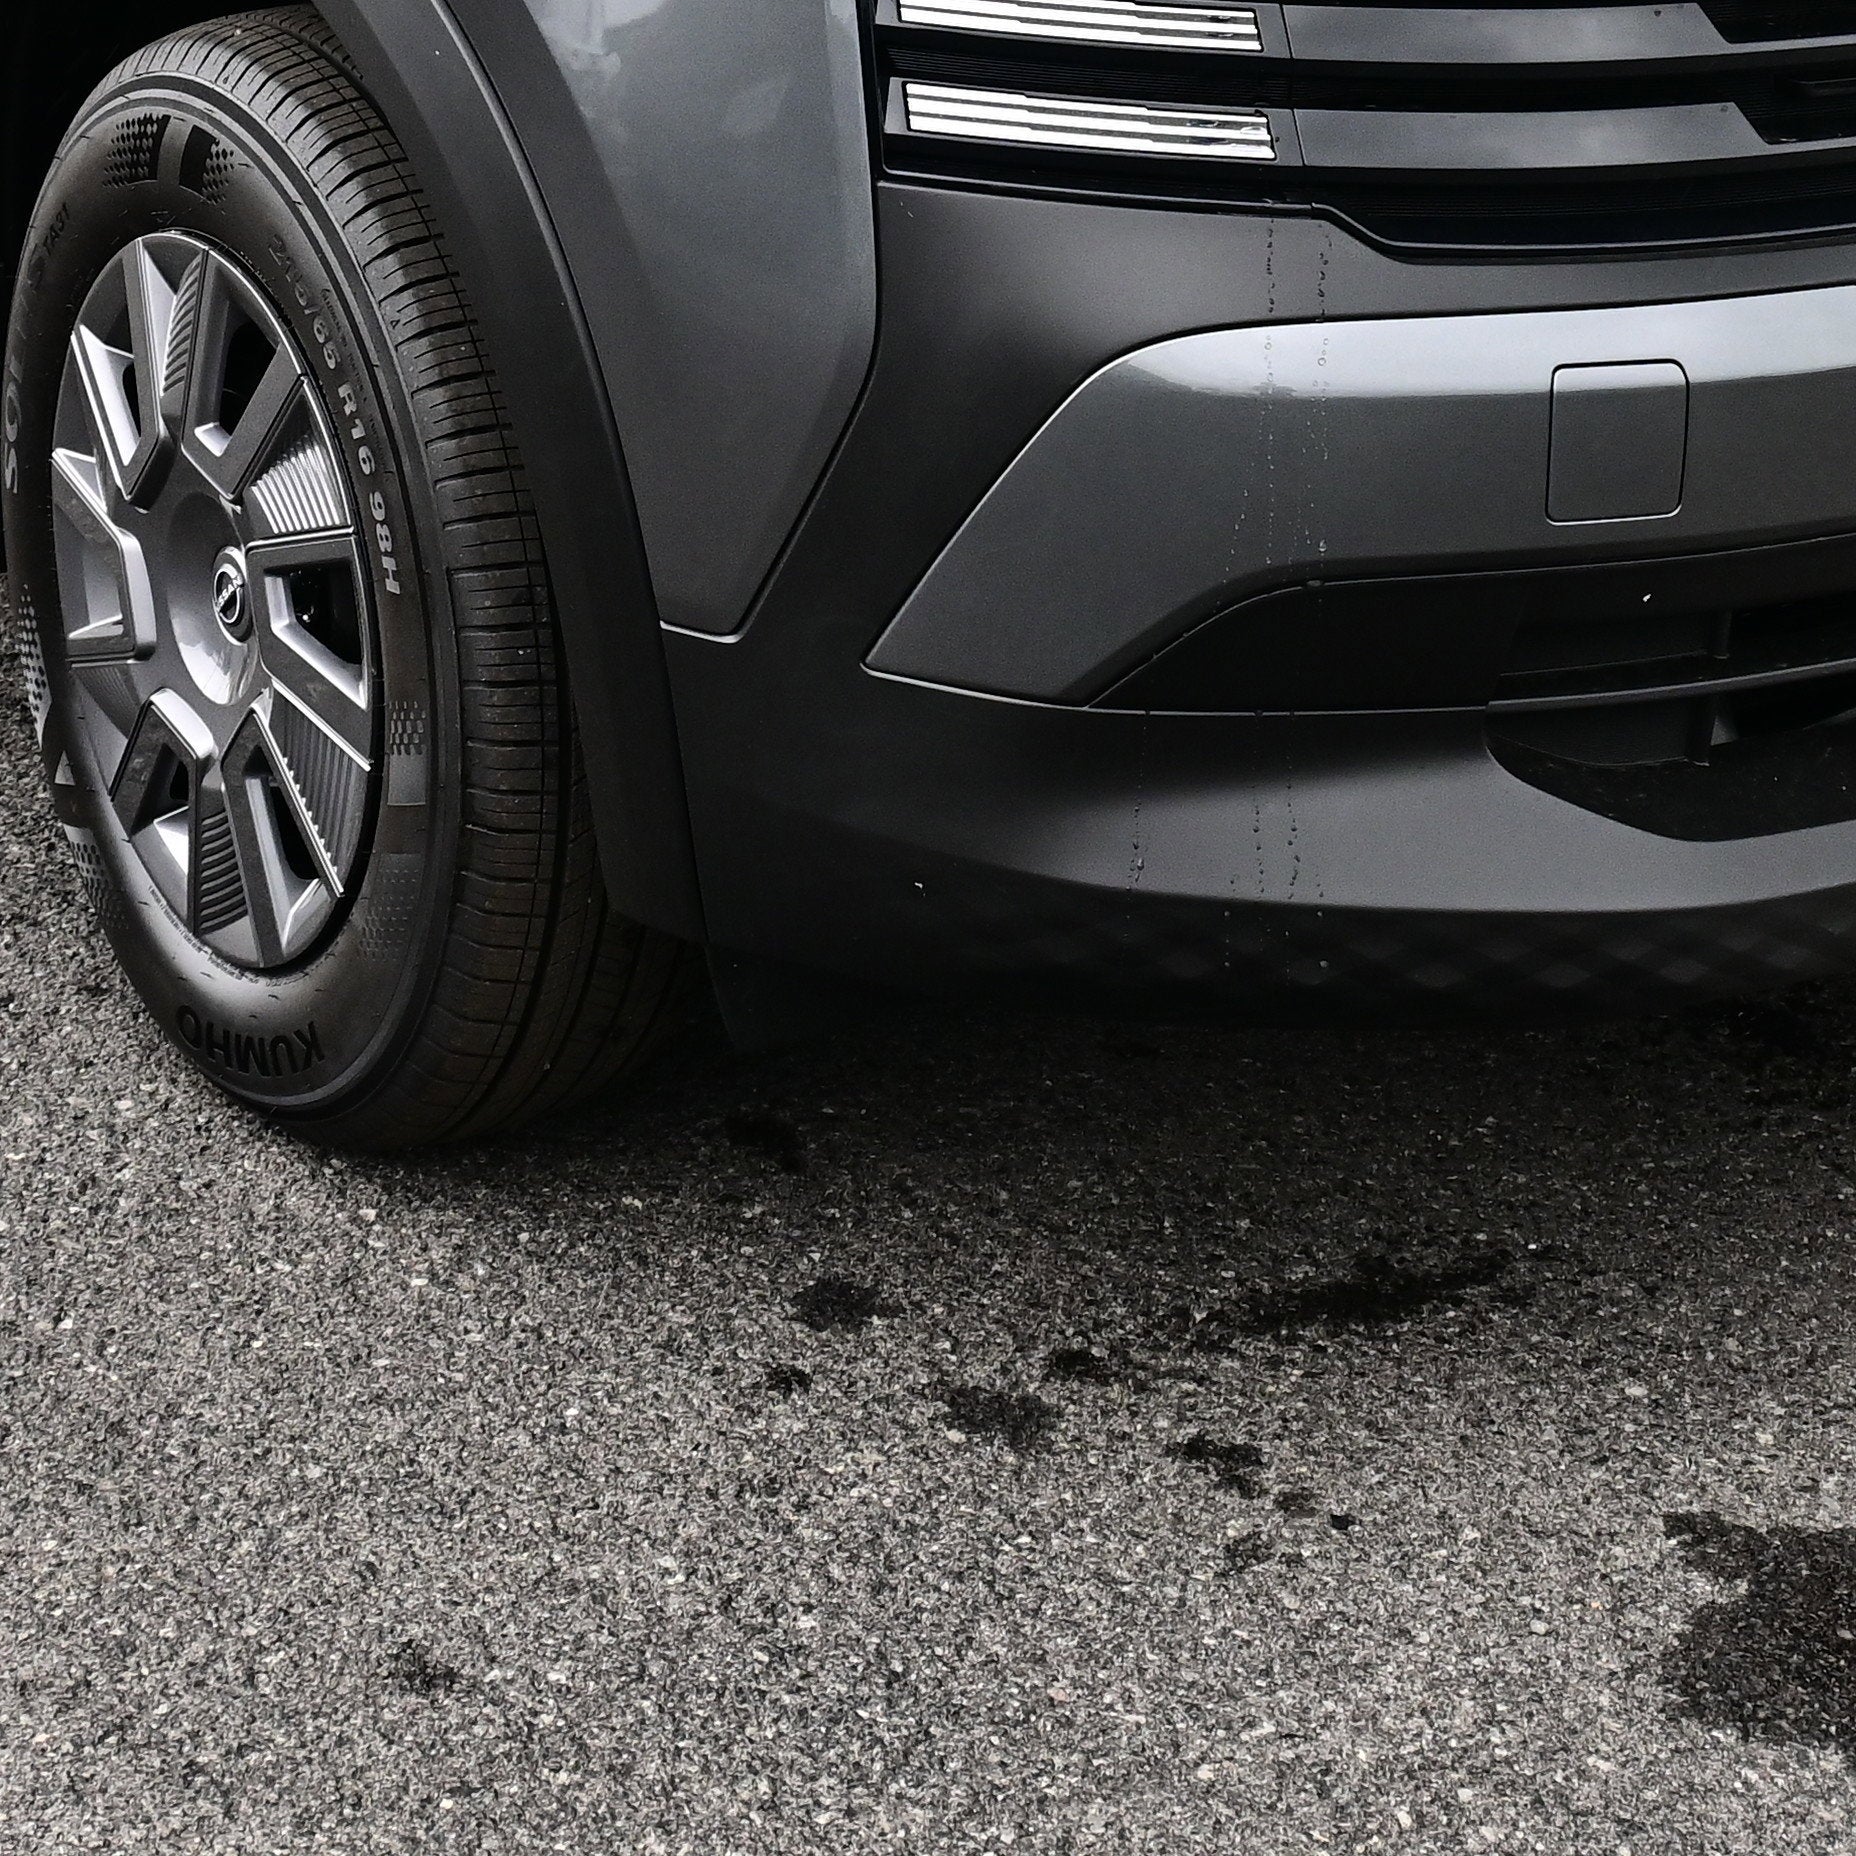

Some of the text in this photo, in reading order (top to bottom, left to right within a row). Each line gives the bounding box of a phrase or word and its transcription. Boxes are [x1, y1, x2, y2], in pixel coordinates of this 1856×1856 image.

[337, 381, 376, 476] R16
[369, 491, 401, 595] 98H
[175, 1004, 326, 1078] KUMHO
